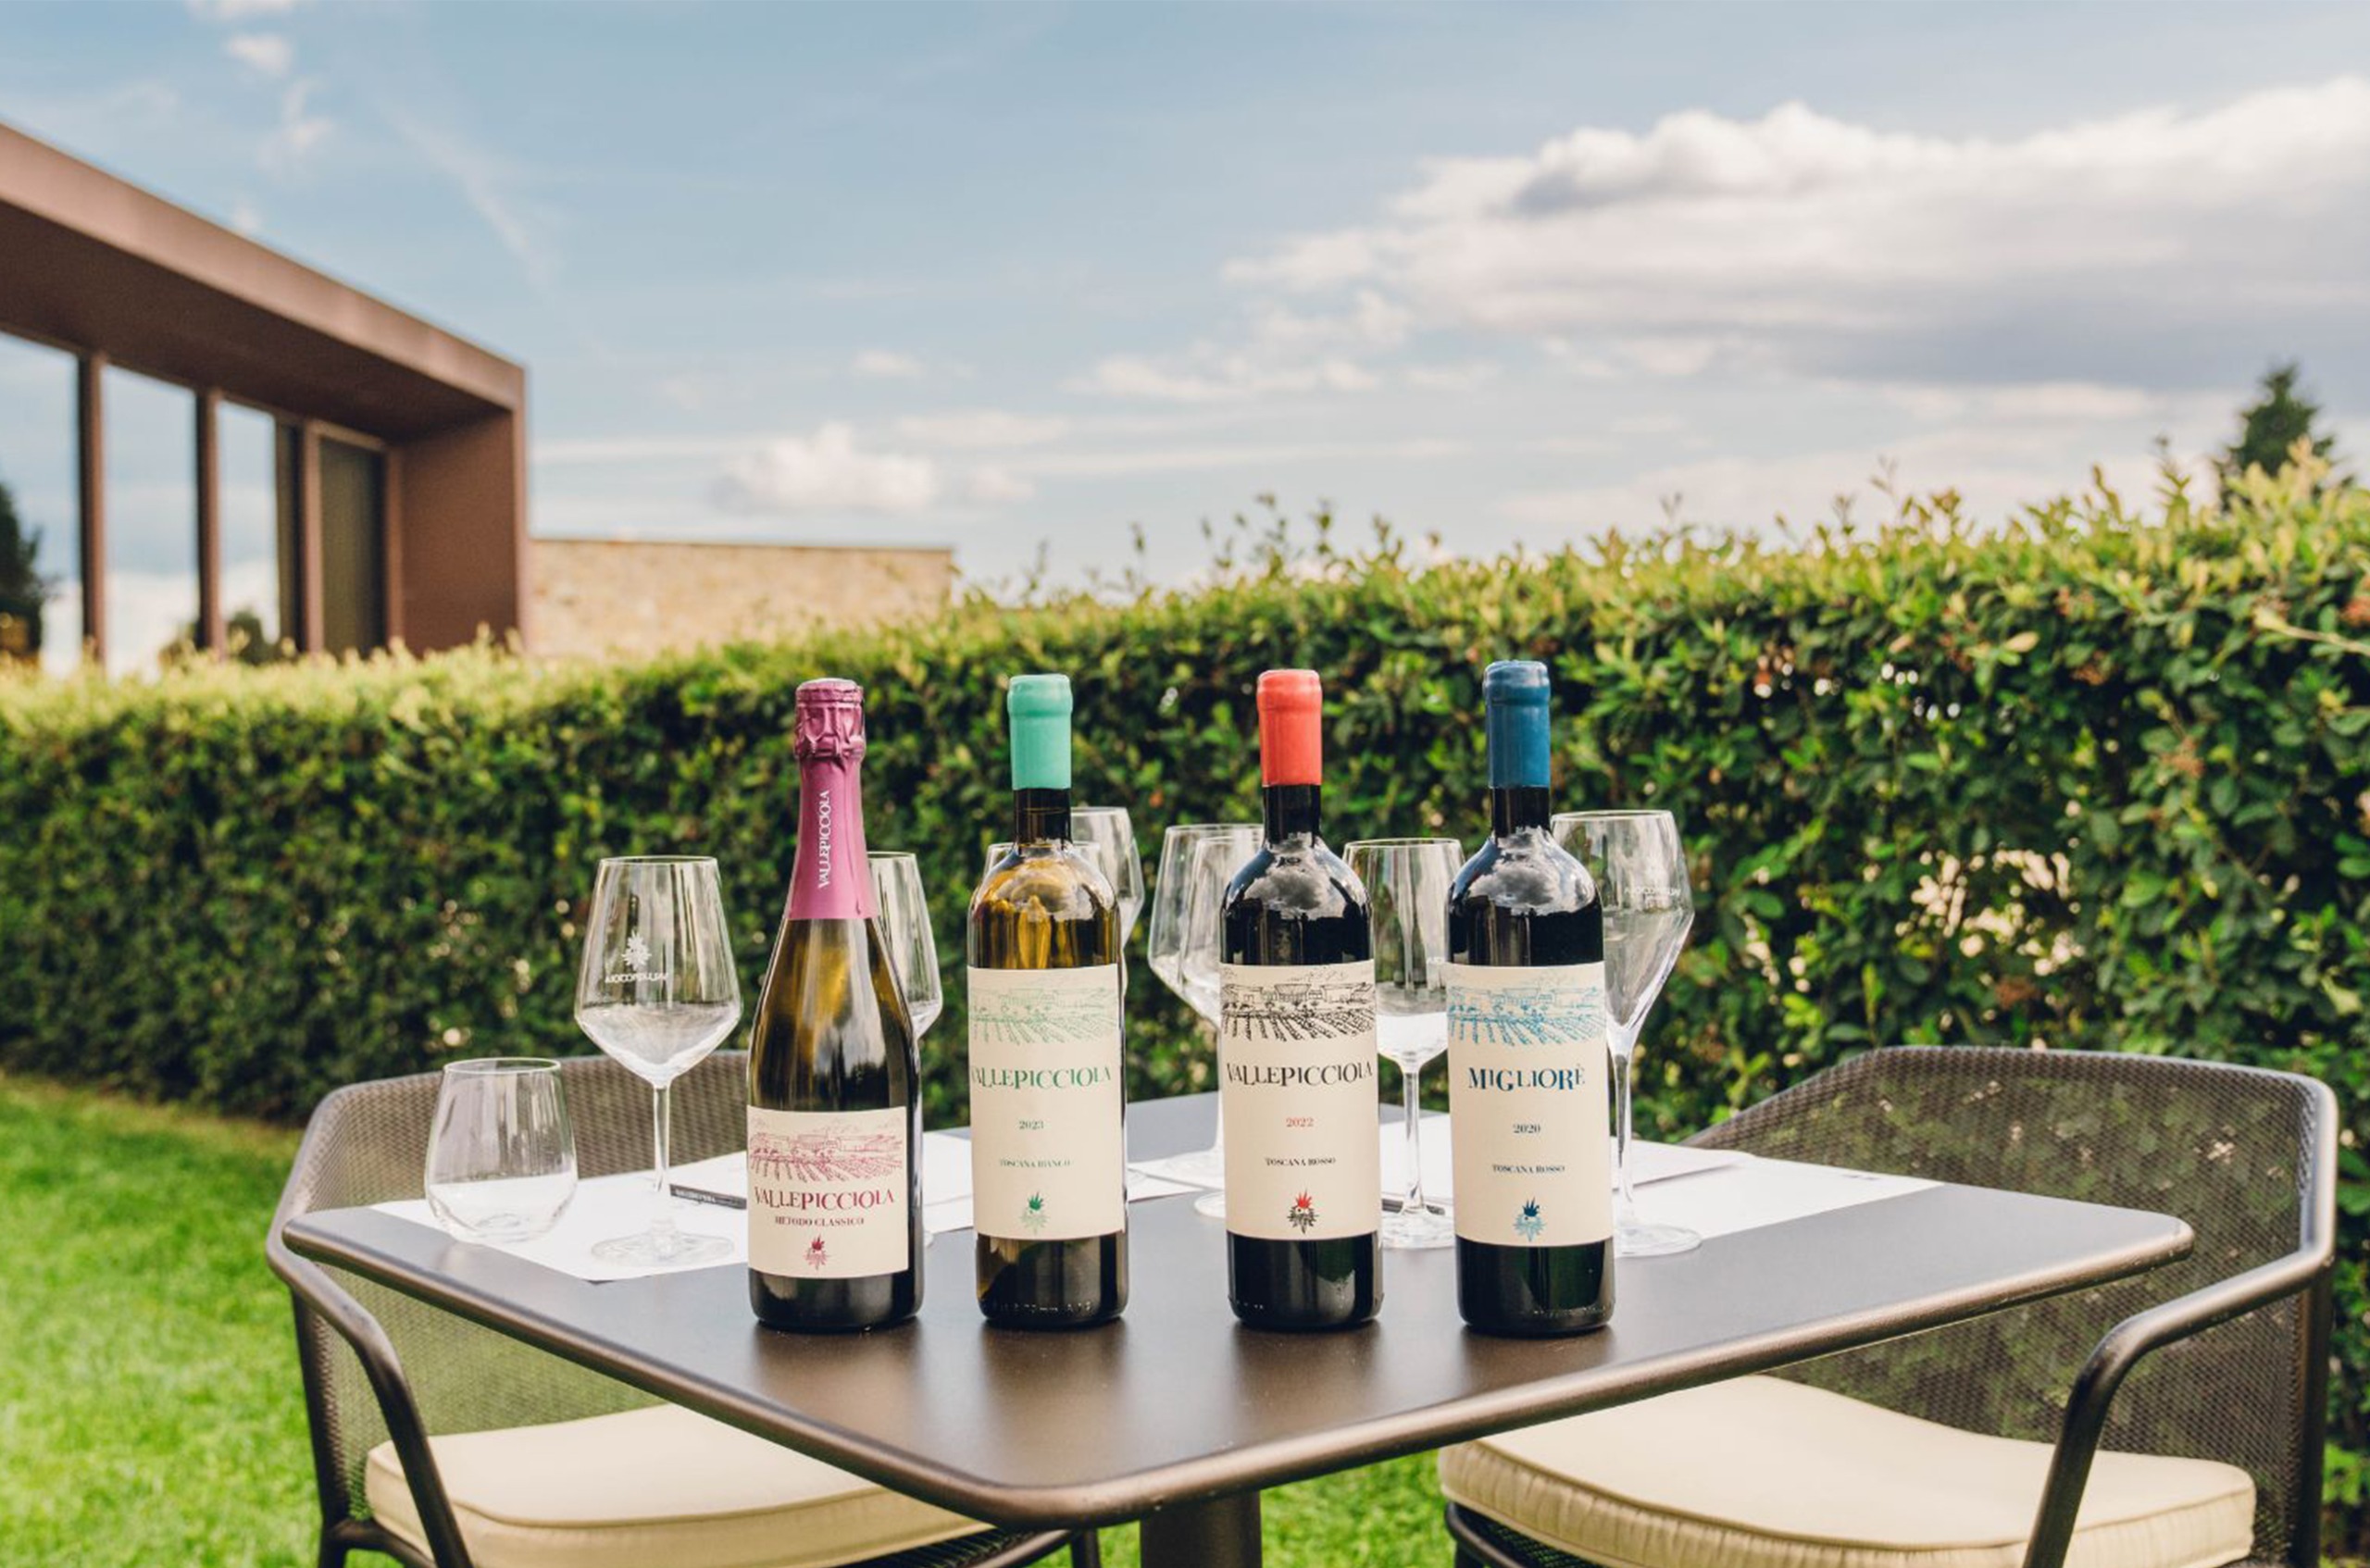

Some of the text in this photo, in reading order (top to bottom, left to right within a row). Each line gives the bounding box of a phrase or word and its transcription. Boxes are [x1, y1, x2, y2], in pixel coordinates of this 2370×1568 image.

[818, 790, 831, 890] VALLEPICCIOLA
[1226, 1061, 1373, 1087] VALLEPICCIOLA
[1467, 1063, 1586, 1091] MIGLIORÈ
[1286, 1117, 1315, 1127] 2022
[1513, 1124, 1541, 1134] 2020
[1265, 1157, 1336, 1166] TOSCANA ROSSO
[1492, 1164, 1565, 1174] TOSCANA ROSSO
[755, 1186, 895, 1211] VALLEPICCIOLA
[775, 1215, 865, 1227] METODO CLASSICO
